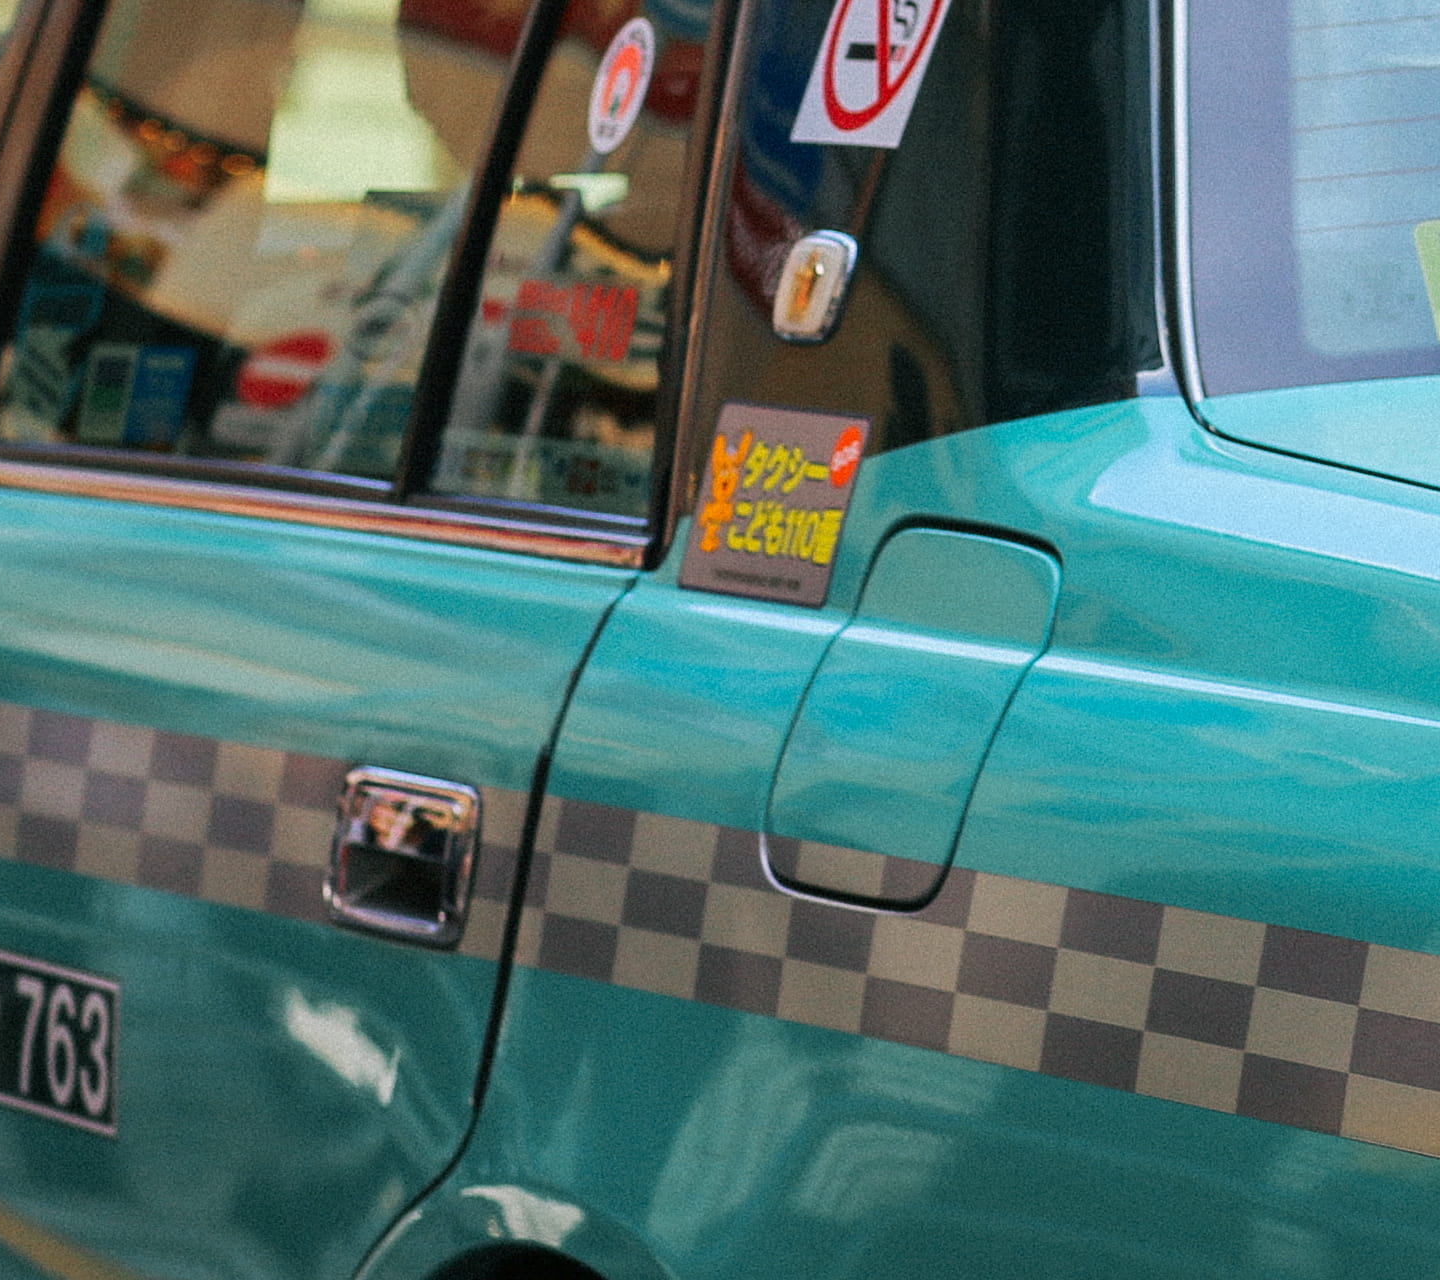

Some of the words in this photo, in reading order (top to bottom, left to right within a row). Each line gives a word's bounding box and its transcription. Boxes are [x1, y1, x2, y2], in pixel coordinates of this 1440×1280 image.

[742, 440, 831, 496] タクシー
[727, 500, 844, 565] こども110番
[15, 974, 110, 1117] 763
